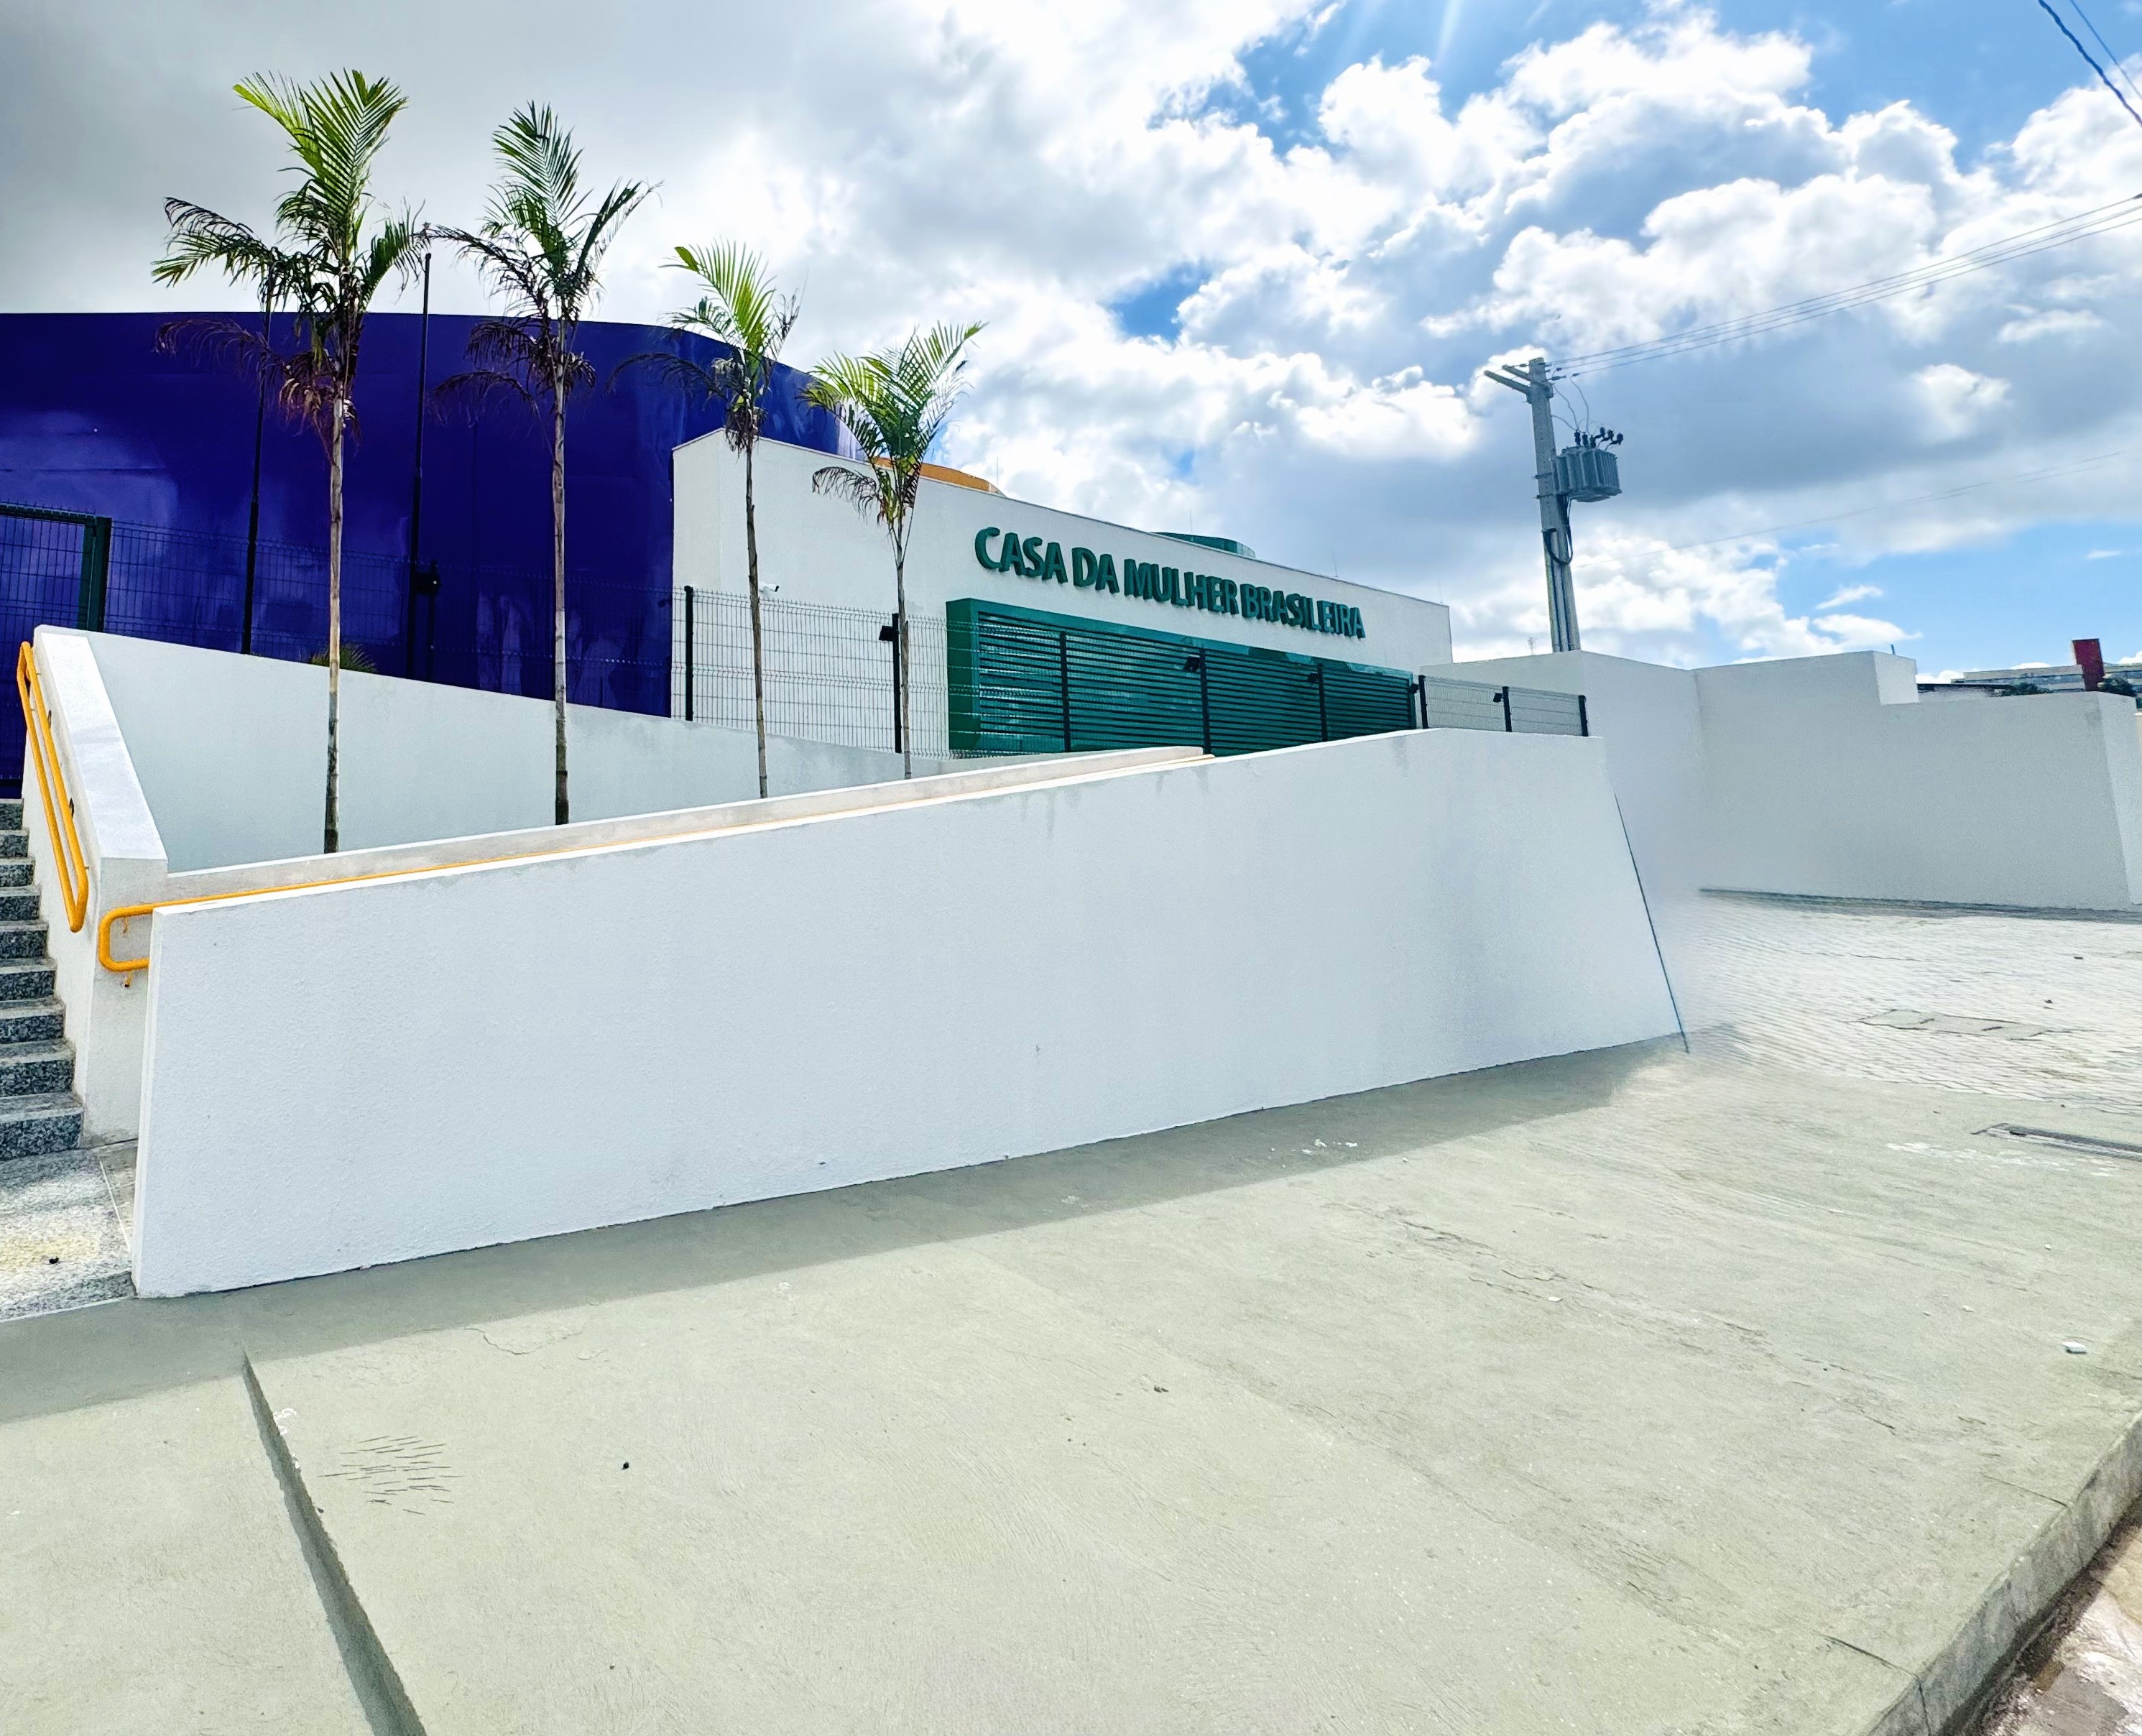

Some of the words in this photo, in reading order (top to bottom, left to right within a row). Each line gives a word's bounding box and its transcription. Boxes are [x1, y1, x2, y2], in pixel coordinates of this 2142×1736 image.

[975, 527, 1068, 583] CASA
[1071, 547, 1120, 594] DA
[1124, 558, 1239, 615] MULHER
[1240, 583, 1366, 639] BRASILEIRA
